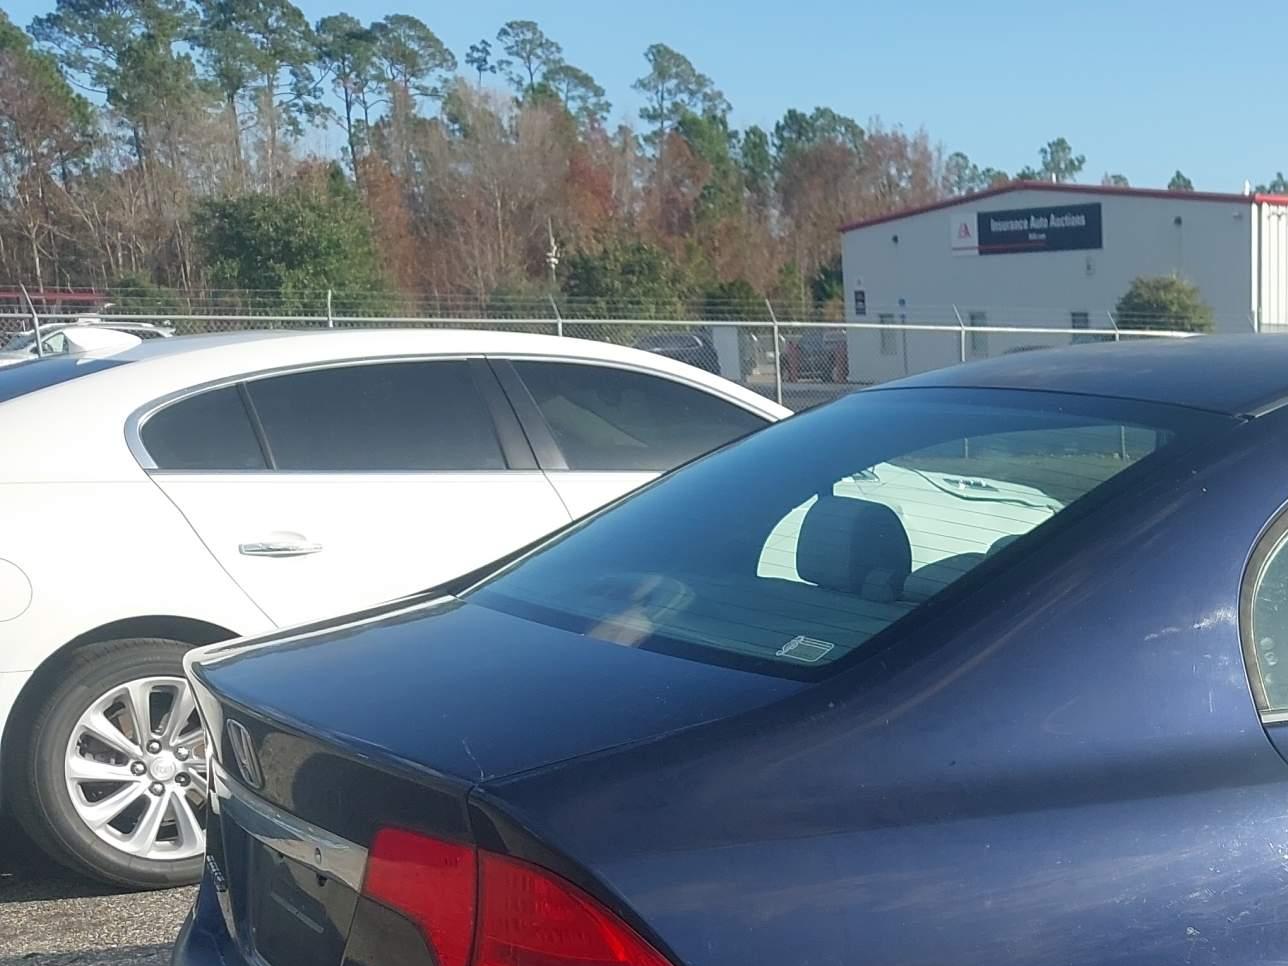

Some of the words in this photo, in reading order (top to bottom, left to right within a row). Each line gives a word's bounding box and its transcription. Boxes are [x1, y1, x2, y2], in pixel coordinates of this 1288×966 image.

[990, 217, 1028, 232] Insurance
[1030, 214, 1048, 229] Auto
[1050, 212, 1086, 228] Auctions
